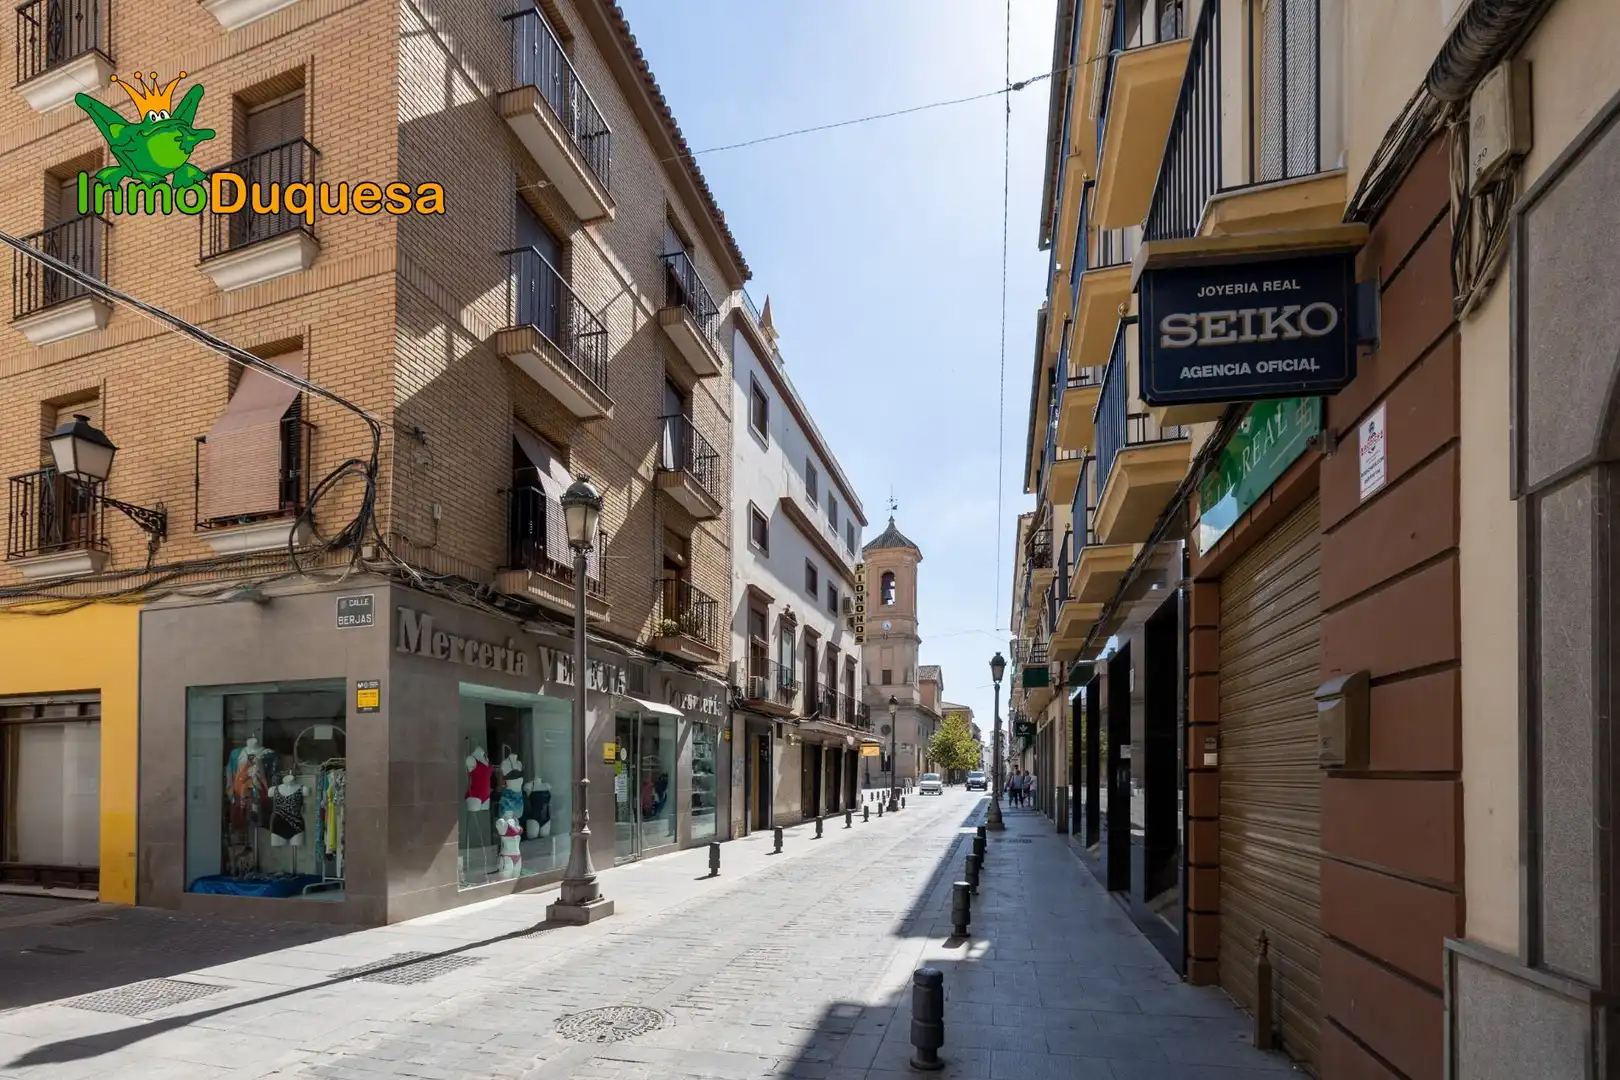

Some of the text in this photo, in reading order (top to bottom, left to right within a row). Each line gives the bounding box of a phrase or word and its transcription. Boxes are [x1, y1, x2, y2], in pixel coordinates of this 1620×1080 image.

[1197, 278, 1301, 298] JOYERIA REAL
[1159, 301, 1338, 349] SEIKO
[1179, 357, 1320, 380] AGENCIA OFICIAL
[1242, 401, 1288, 480] REAL
[338, 613, 373, 626] BERJAS
[348, 597, 370, 607] CALLE
[855, 563, 865, 644] PIONONOS
[396, 606, 529, 677] Mercería
[537, 645, 627, 697] VEECIA
